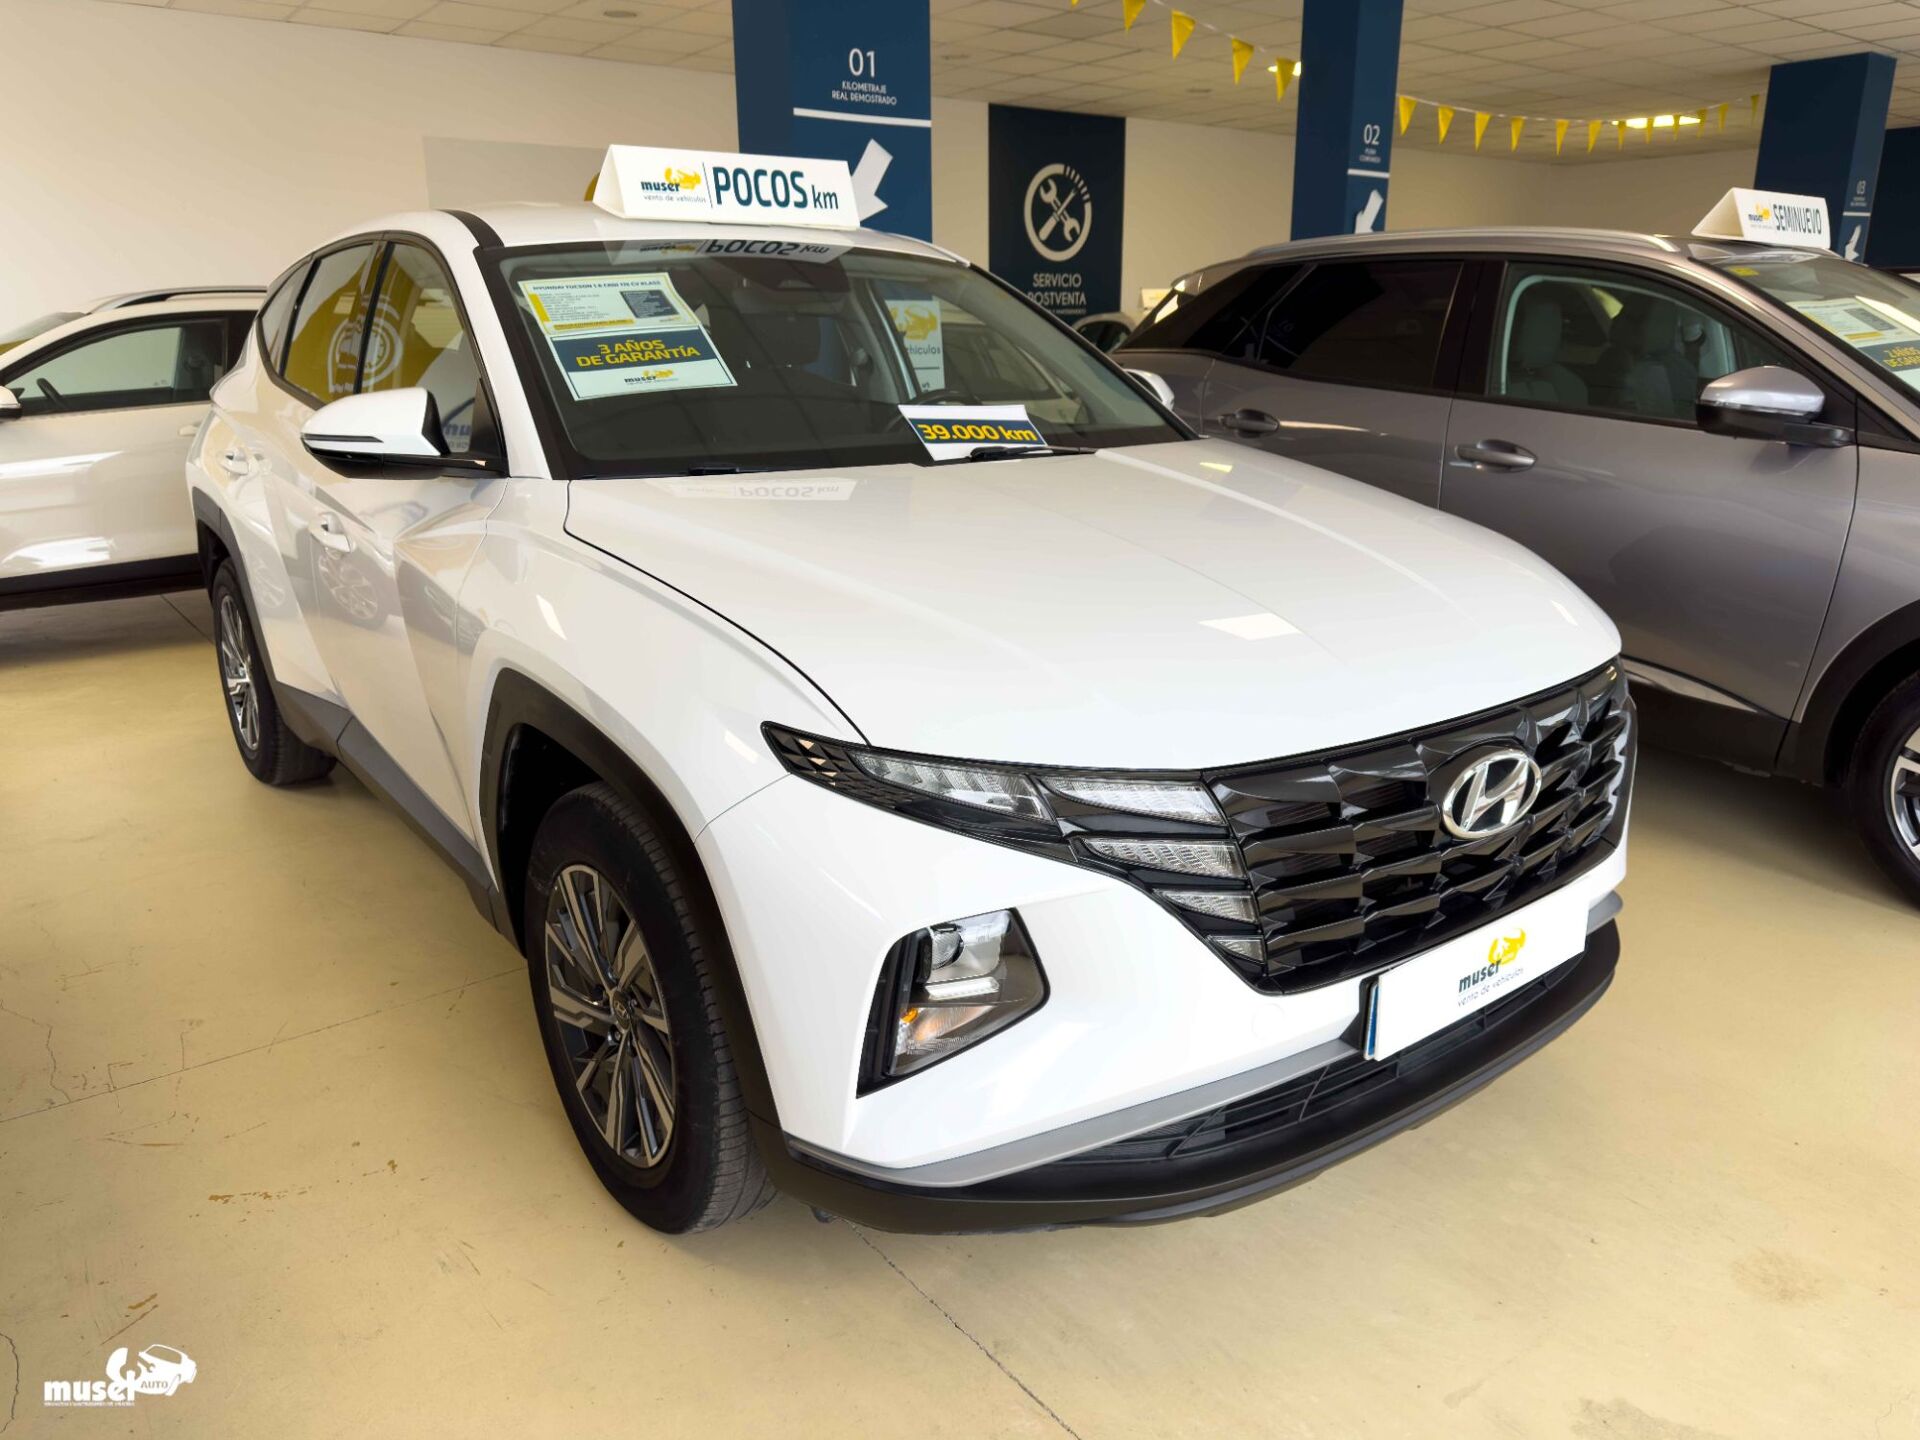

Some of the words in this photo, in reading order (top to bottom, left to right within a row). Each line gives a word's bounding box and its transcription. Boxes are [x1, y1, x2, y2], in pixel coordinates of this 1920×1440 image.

[849, 48, 875, 78] 01
[831, 89, 849, 101] REAL
[850, 92, 897, 105] DEMOSTRADO
[841, 80, 887, 95] KILOMETRAJE
[1363, 123, 1380, 145] 02
[640, 181, 680, 192] muser
[712, 166, 808, 209] POCOS
[811, 184, 839, 210] km
[1773, 203, 1822, 235] SEMINUEVO
[1032, 273, 1082, 288] SERVICIO
[575, 355, 602, 367] DE
[605, 345, 701, 364] GARANTÍA
[598, 344, 610, 356] 3
[613, 339, 665, 354] AÑOS
[917, 424, 999, 441] 39.000
[999, 425, 1039, 442] km
[1458, 958, 1502, 993] muser
